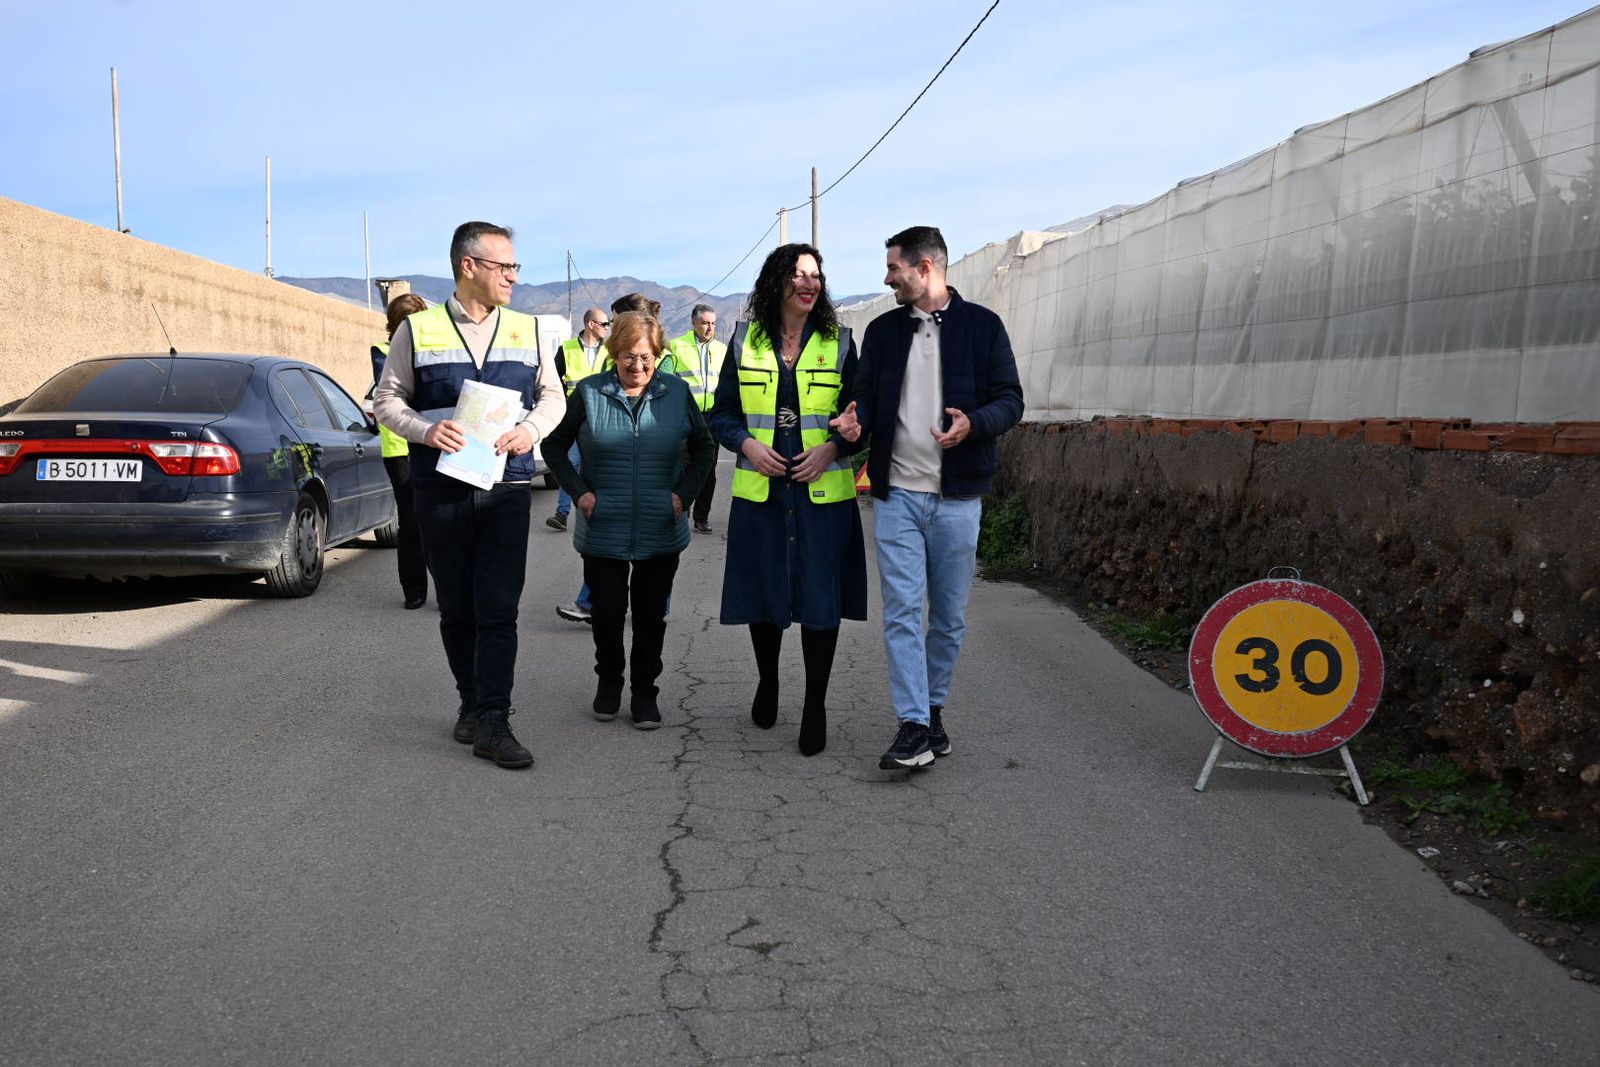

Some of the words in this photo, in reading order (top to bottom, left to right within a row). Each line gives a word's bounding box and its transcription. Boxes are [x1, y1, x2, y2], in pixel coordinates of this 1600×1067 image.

[50, 462, 60, 478] B
[65, 462, 107, 478] 5011
[116, 463, 137, 478] VM
[1235, 637, 1342, 696] 30
